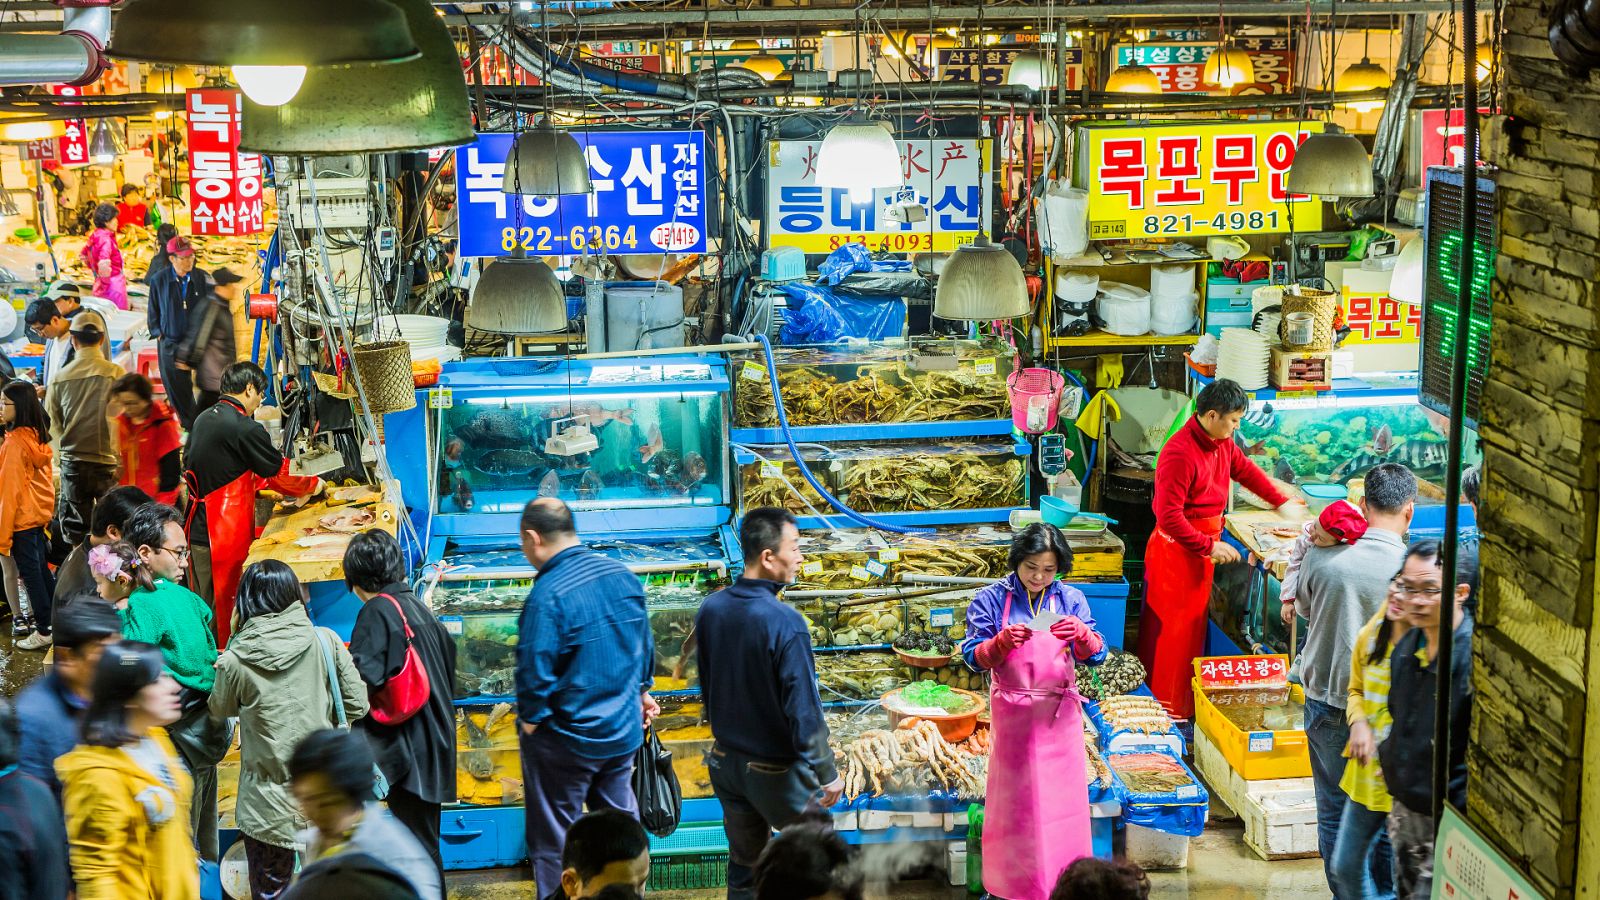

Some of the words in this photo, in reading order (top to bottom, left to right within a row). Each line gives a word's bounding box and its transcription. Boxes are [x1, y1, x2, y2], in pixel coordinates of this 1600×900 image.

[190, 93, 233, 199] 녹동
[672, 143, 700, 217] 자연산
[193, 201, 235, 234] 수산
[238, 198, 263, 231] 수산
[1144, 211, 1279, 235] 821-4981
[501, 225, 638, 251] 822-6364
[1201, 660, 1252, 679] 자연산
[1254, 659, 1287, 678] 광어
